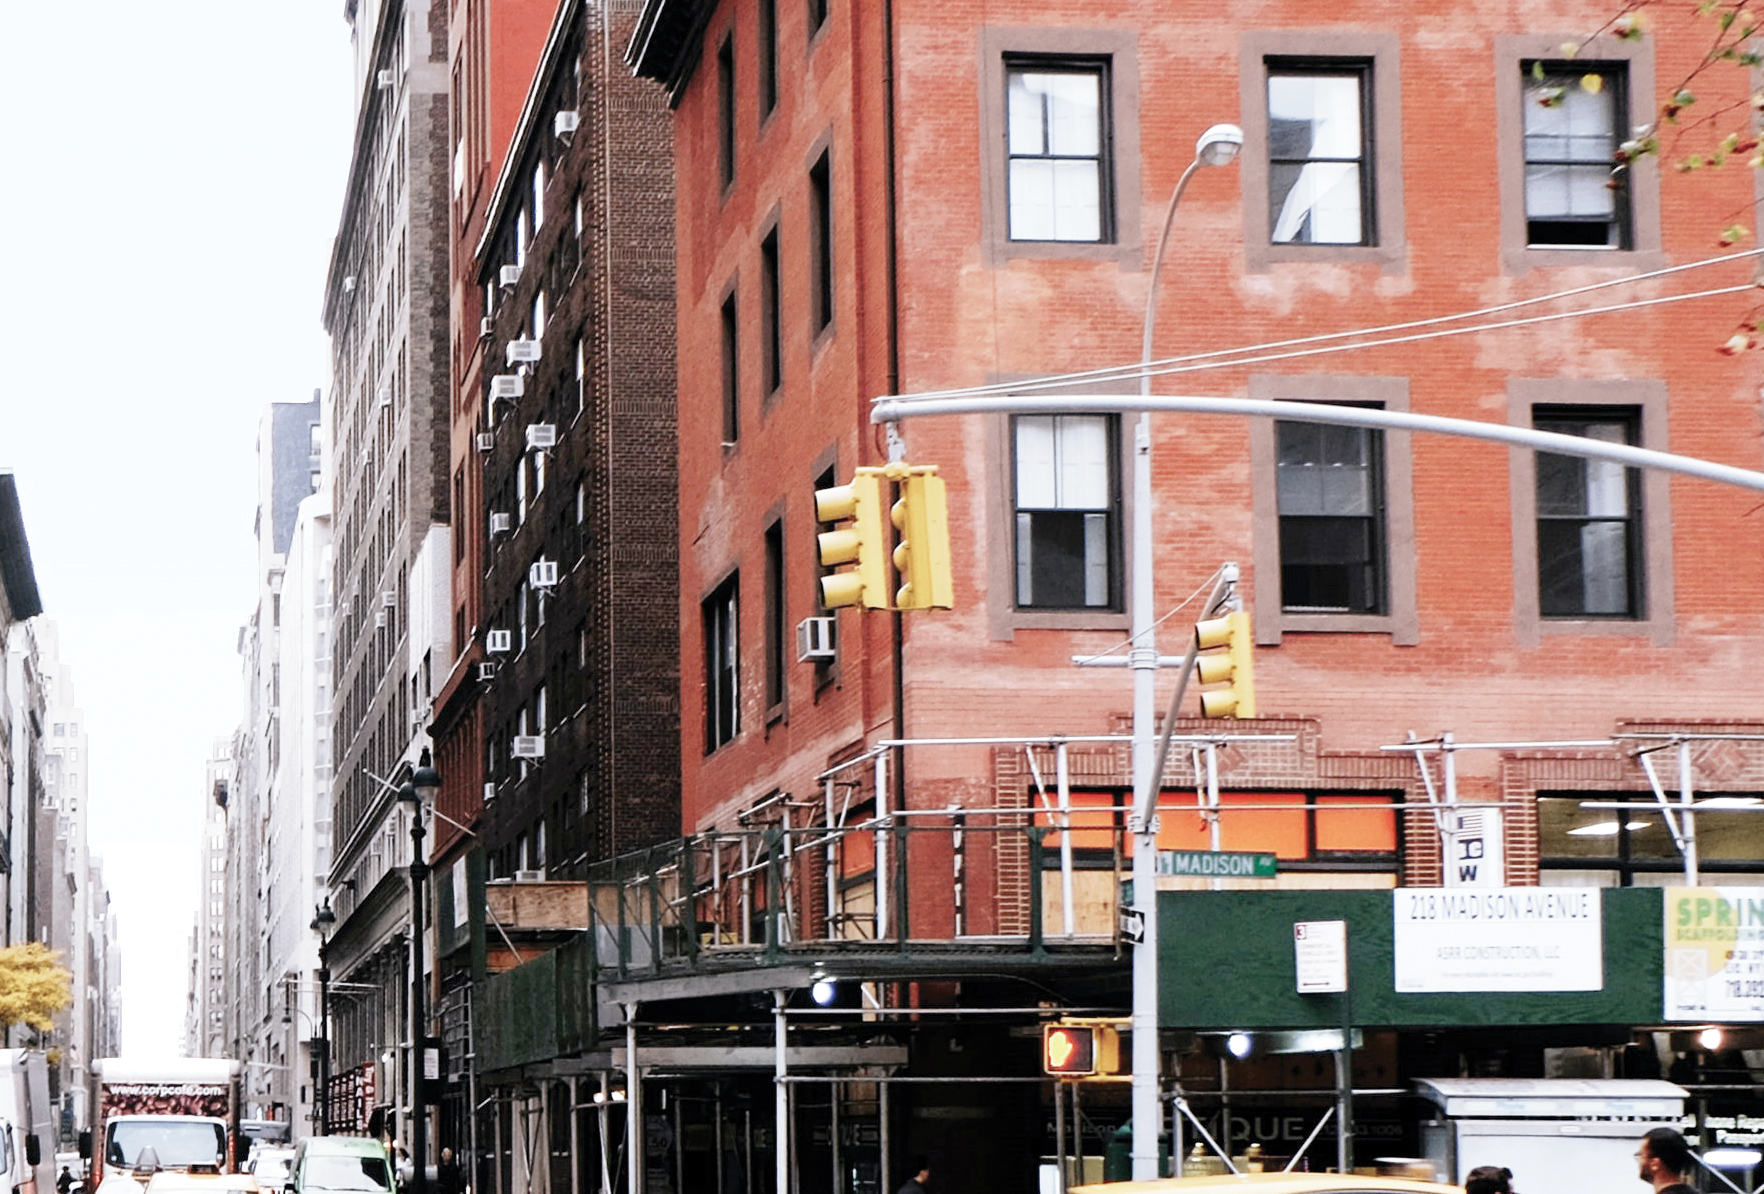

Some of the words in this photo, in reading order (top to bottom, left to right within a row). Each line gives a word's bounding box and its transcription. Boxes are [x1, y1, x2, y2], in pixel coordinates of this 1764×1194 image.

[1175, 854, 1254, 875] MADISON
[1411, 894, 1436, 919] 218
[1442, 894, 1519, 919] MADISON
[1524, 893, 1588, 919] AVENUE
[1045, 1122, 1115, 1134] Maison
